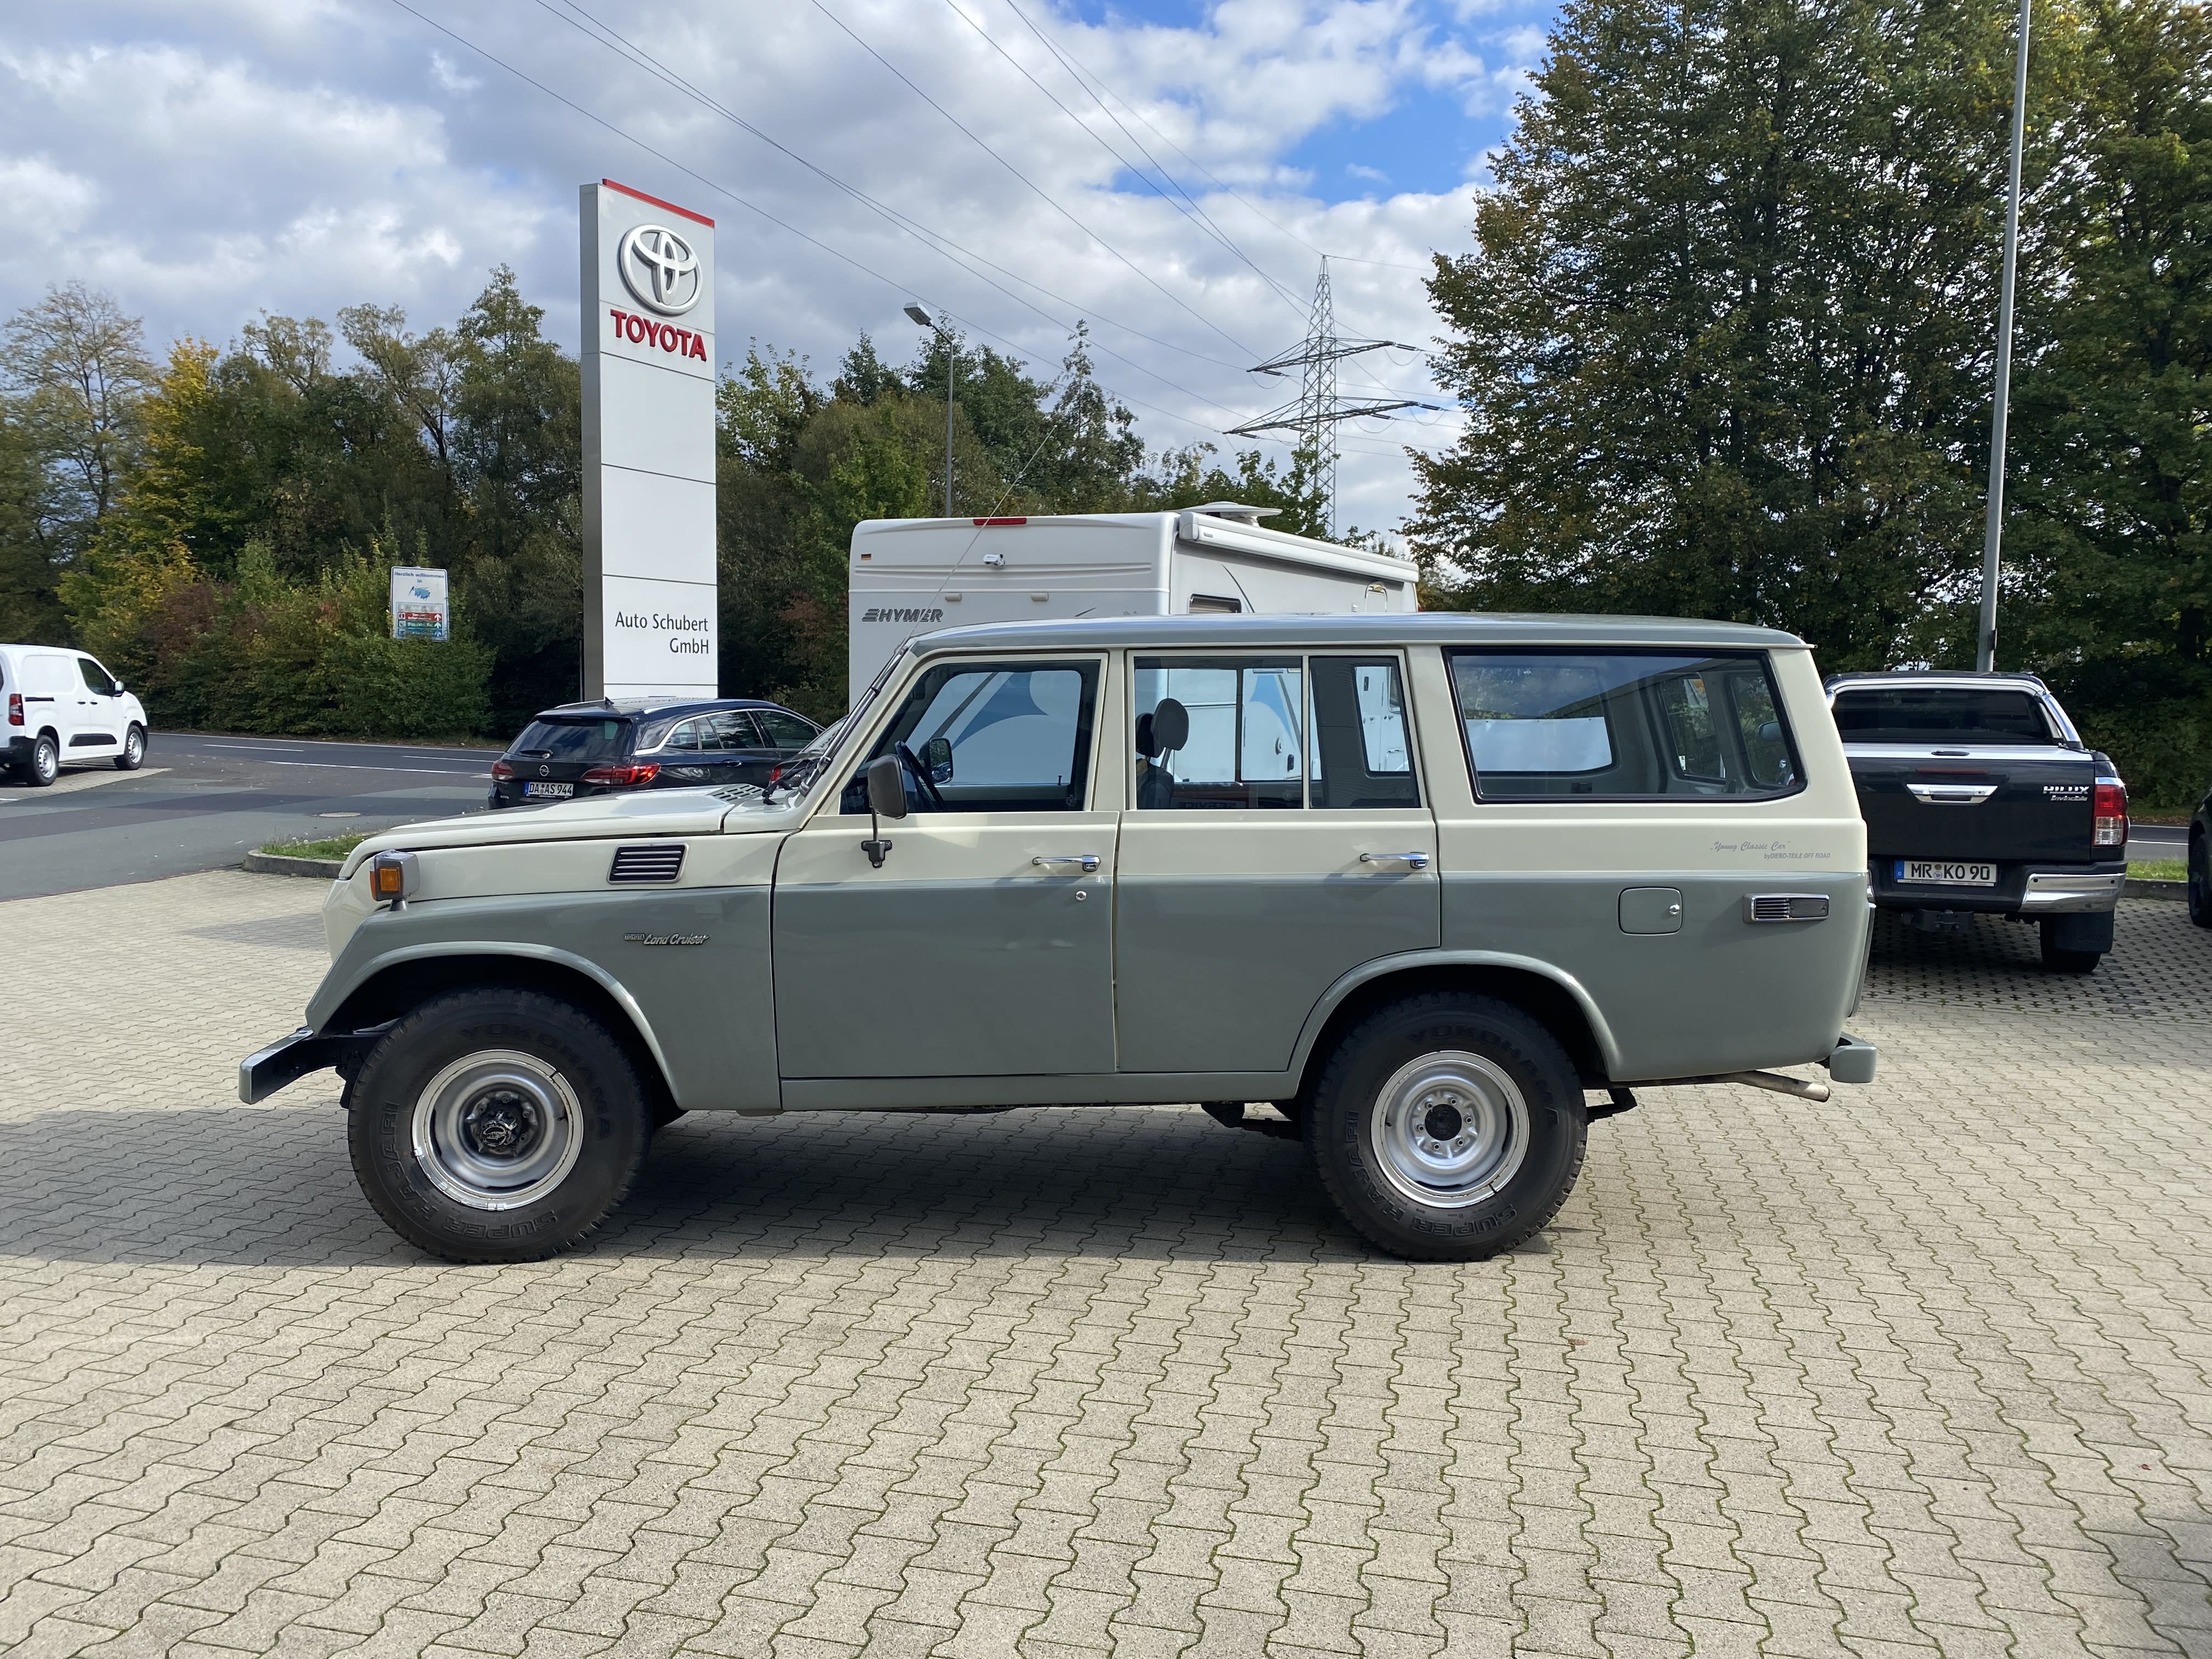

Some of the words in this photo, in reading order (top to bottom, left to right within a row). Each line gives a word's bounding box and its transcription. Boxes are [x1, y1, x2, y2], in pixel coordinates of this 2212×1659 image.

[610, 309, 707, 362] TOYOTA
[615, 611, 647, 628] Auto
[653, 613, 708, 631] Schubert
[669, 637, 709, 654] GmbH
[529, 783, 539, 793] DA
[544, 785, 555, 794] AS
[557, 785, 572, 795] 944
[1741, 841, 1767, 851] Classic
[1911, 864, 1932, 878] MR
[1944, 865, 1965, 879] KO
[1970, 866, 1990, 880] 90
[644, 934, 671, 945] Land
[670, 933, 711, 945] Cruiser
